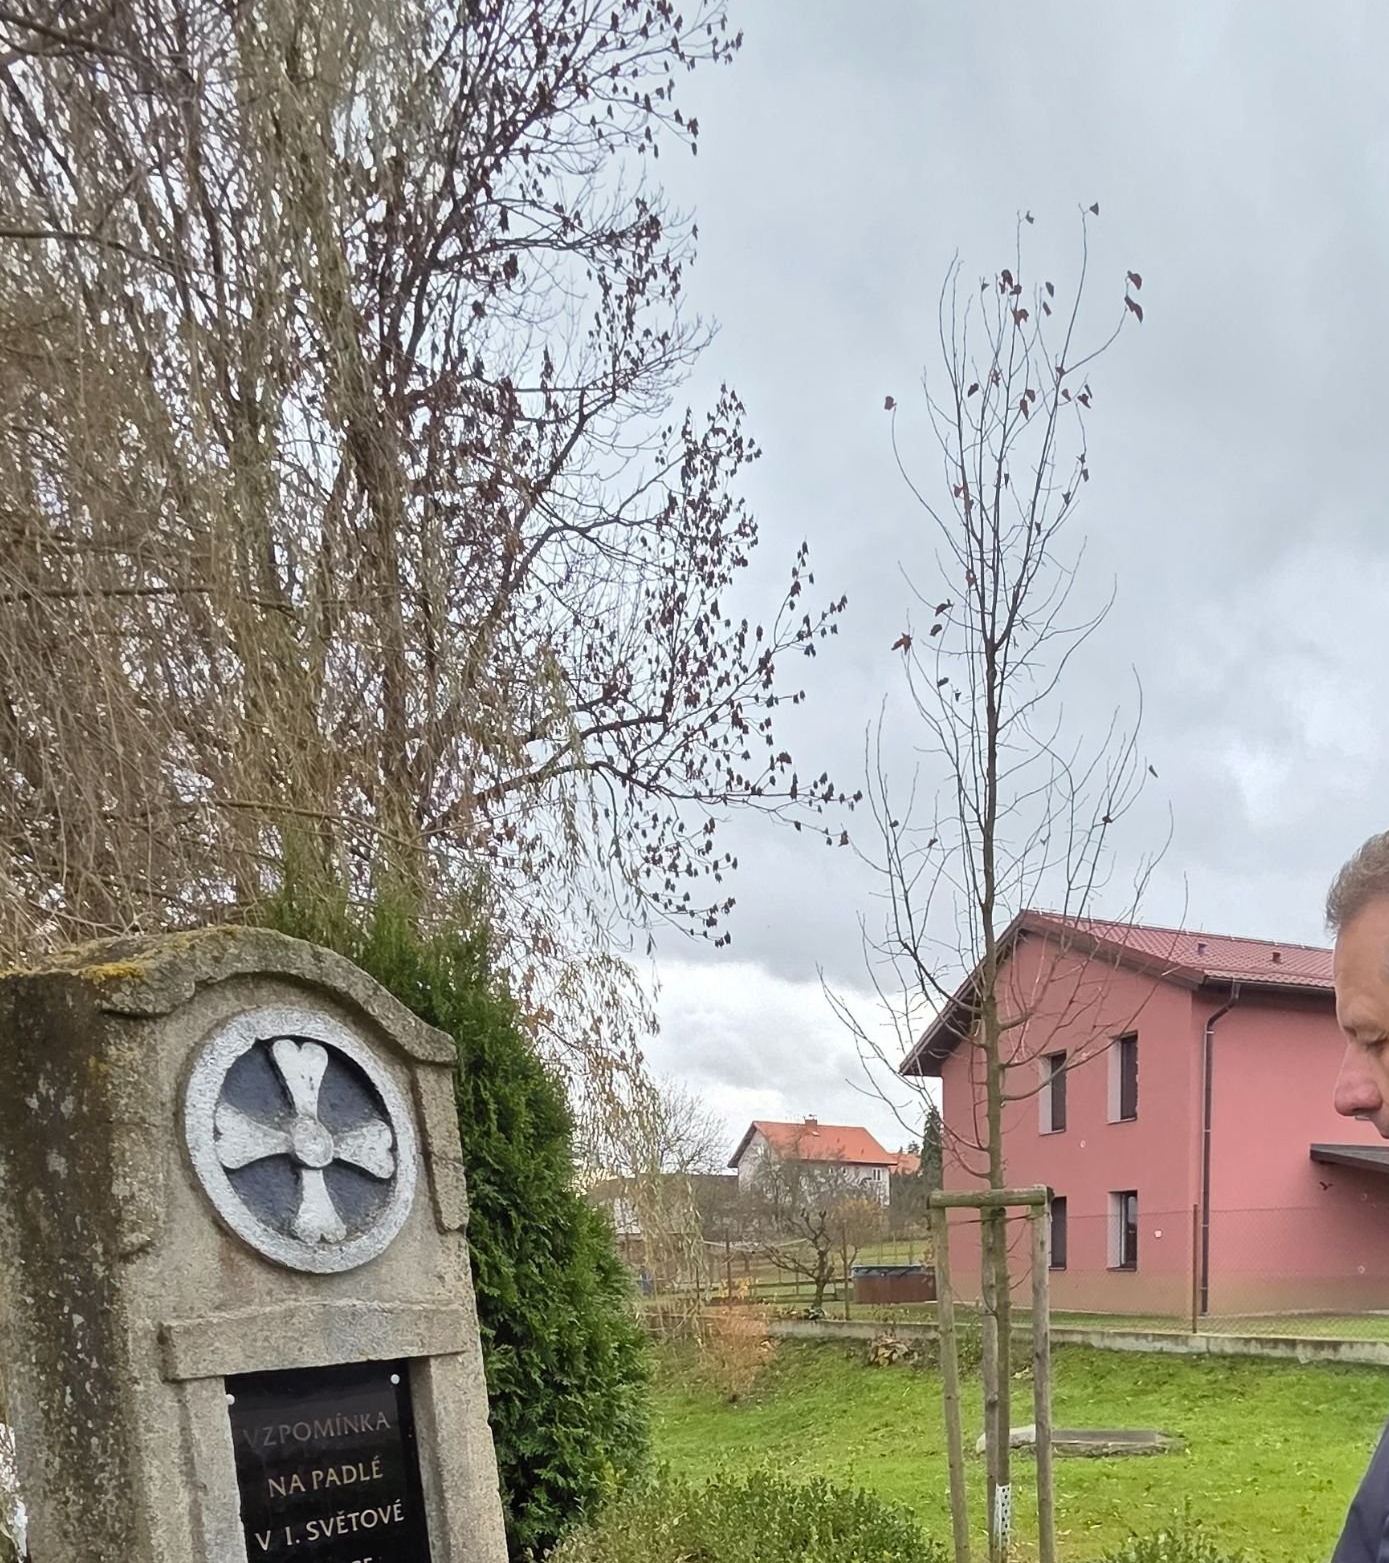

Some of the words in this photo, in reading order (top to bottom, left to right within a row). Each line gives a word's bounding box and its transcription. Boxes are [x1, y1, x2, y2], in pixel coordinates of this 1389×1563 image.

[243, 1411, 391, 1447] VZPOMÍNKA
[268, 1474, 306, 1498] NA
[312, 1455, 384, 1491] PADLÉ
[255, 1530, 271, 1551] V
[285, 1526, 300, 1546] I.
[306, 1498, 405, 1541] SVĚTOVÉ
